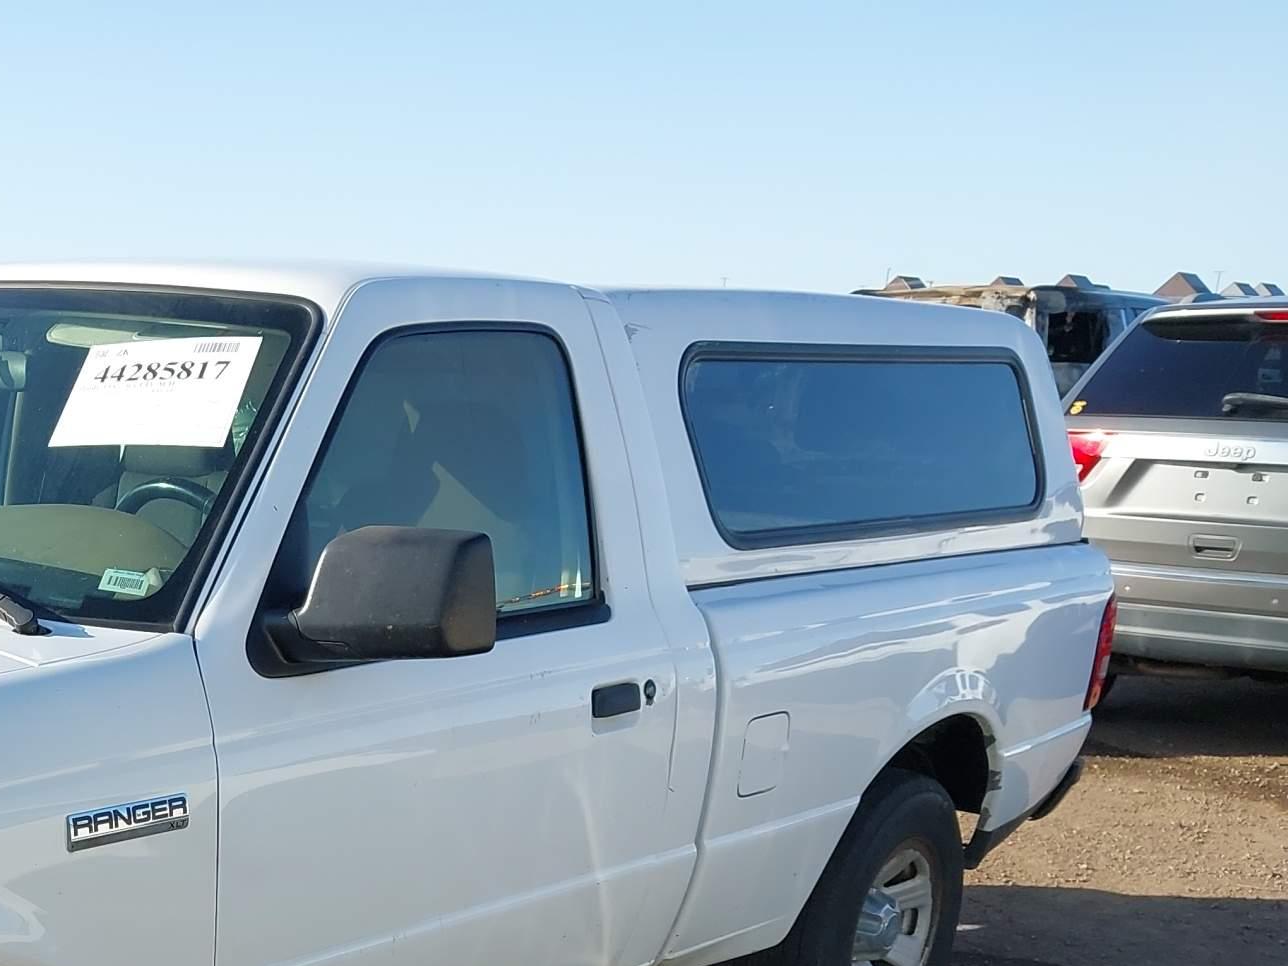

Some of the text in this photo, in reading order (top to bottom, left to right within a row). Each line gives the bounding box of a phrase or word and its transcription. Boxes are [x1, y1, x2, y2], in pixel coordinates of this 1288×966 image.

[94, 360, 231, 383] 44285817
[1205, 442, 1257, 461] Jeep
[71, 796, 188, 837] RANGER
